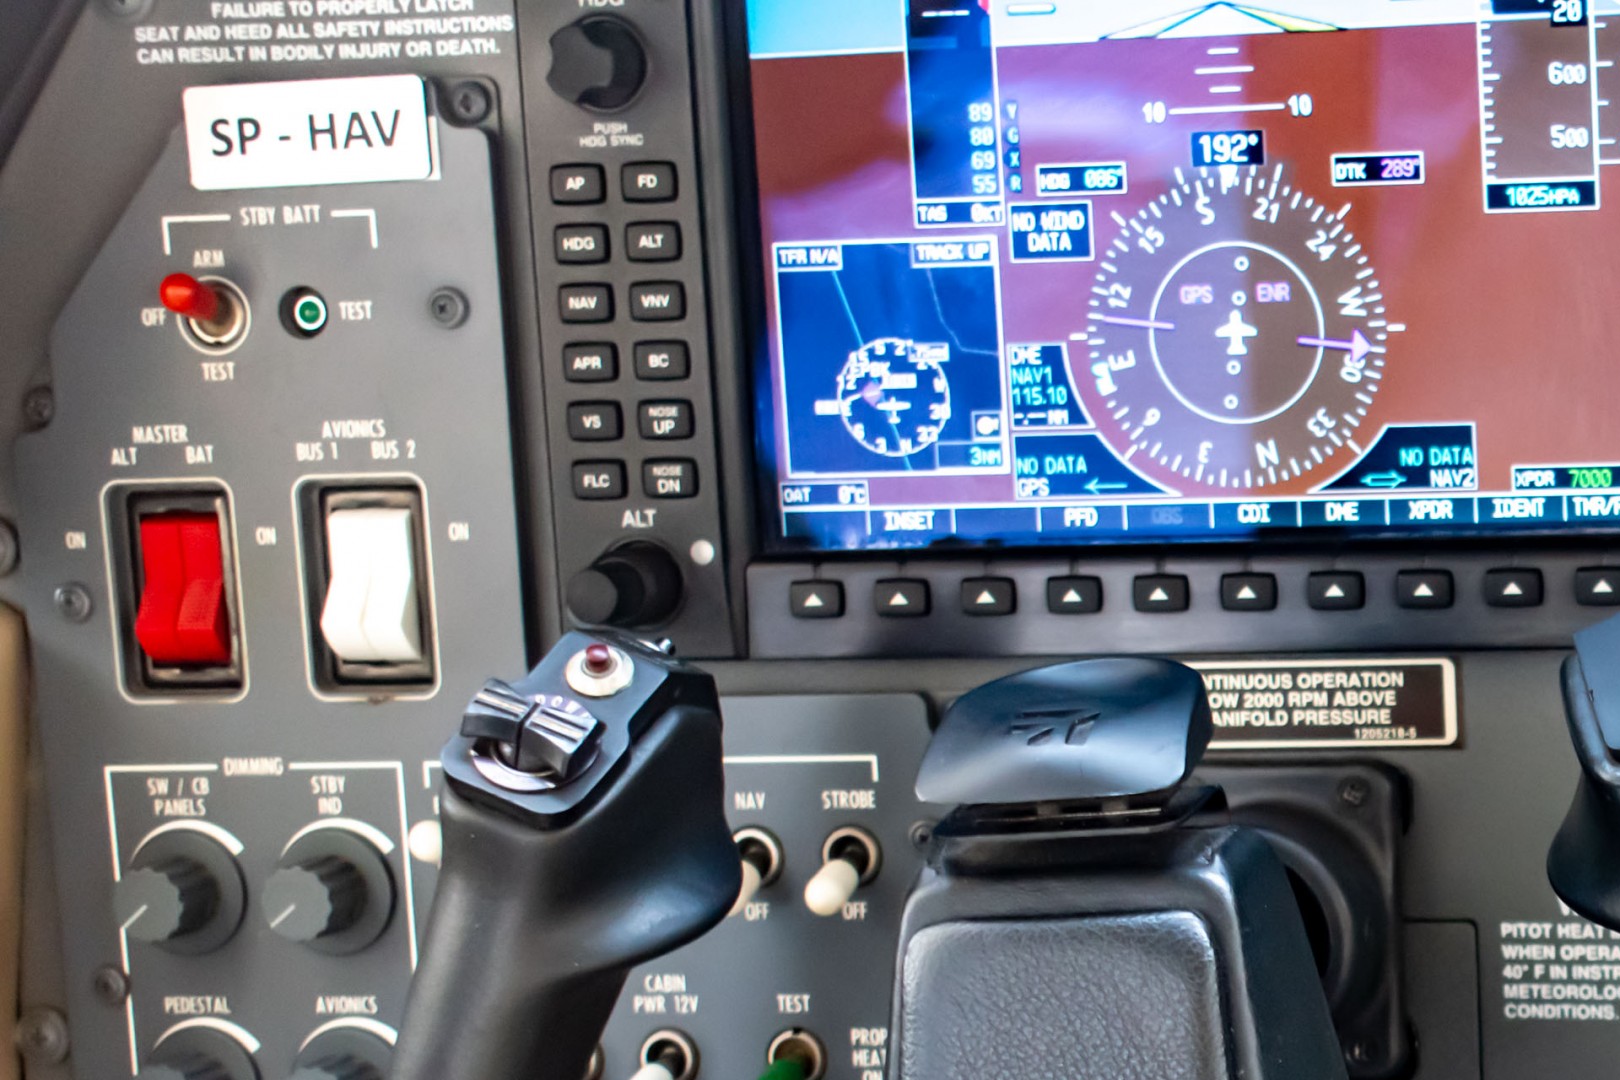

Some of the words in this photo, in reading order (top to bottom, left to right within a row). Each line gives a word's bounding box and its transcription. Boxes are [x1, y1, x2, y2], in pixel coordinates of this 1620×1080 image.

[135, 27, 180, 44] SEAT
[184, 25, 221, 42] AND
[224, 24, 273, 41] HEED
[276, 22, 311, 39] ALL
[313, 20, 381, 38] SAFETY
[383, 14, 514, 36] INSTRUCTIONS
[137, 47, 174, 65] CAN
[178, 45, 245, 63] RESULT
[248, 44, 268, 62] IN
[271, 43, 335, 62] BODILY
[338, 41, 401, 60] INJURY
[405, 40, 432, 58] OR
[436, 38, 501, 57] DEATH.
[1548, 62, 1586, 85] 600
[210, 119, 261, 156] SP
[308, 108, 402, 152] HAV
[1551, 125, 1589, 148] 500
[1335, 163, 1366, 181] DTK
[240, 207, 279, 227] STBY
[282, 205, 321, 225] BATT
[338, 301, 373, 321] TEST
[201, 361, 236, 382] TEST
[1011, 366, 1053, 385] NAV1
[1011, 386, 1068, 406] 115.10
[132, 425, 189, 445] MASTER
[321, 418, 387, 440] AVIONICS
[111, 447, 138, 468] ALT
[186, 444, 214, 465] BAT
[296, 441, 326, 461] BUS
[330, 440, 339, 460] 1
[370, 439, 402, 459] BUS
[406, 438, 416, 459] 2
[1400, 447, 1424, 467] NO
[1429, 445, 1475, 466] DATA
[1430, 468, 1475, 488] NAV2
[1515, 469, 1556, 488] XPDR
[1569, 467, 1612, 488] 7000
[1493, 498, 1546, 519] IDENT
[1297, 672, 1404, 689] OPERATION
[1243, 693, 1284, 709] 2000
[1289, 692, 1328, 708] RPM
[1333, 691, 1397, 707] ABOVE
[1292, 709, 1392, 726] PRESSURE
[223, 757, 284, 777] DIMMING
[310, 775, 347, 796] STBY
[154, 796, 207, 816] PANELS
[734, 791, 766, 811] NAV
[821, 789, 877, 811] STROBE
[644, 975, 687, 994] CABIN
[163, 994, 232, 1016] PEDESTAL
[315, 994, 379, 1016] AVIONICS
[633, 995, 667, 1014] PWR
[673, 995, 700, 1014] 12V
[776, 994, 812, 1013] TEST
[1504, 1003, 1620, 1021] CONDITIONS.
